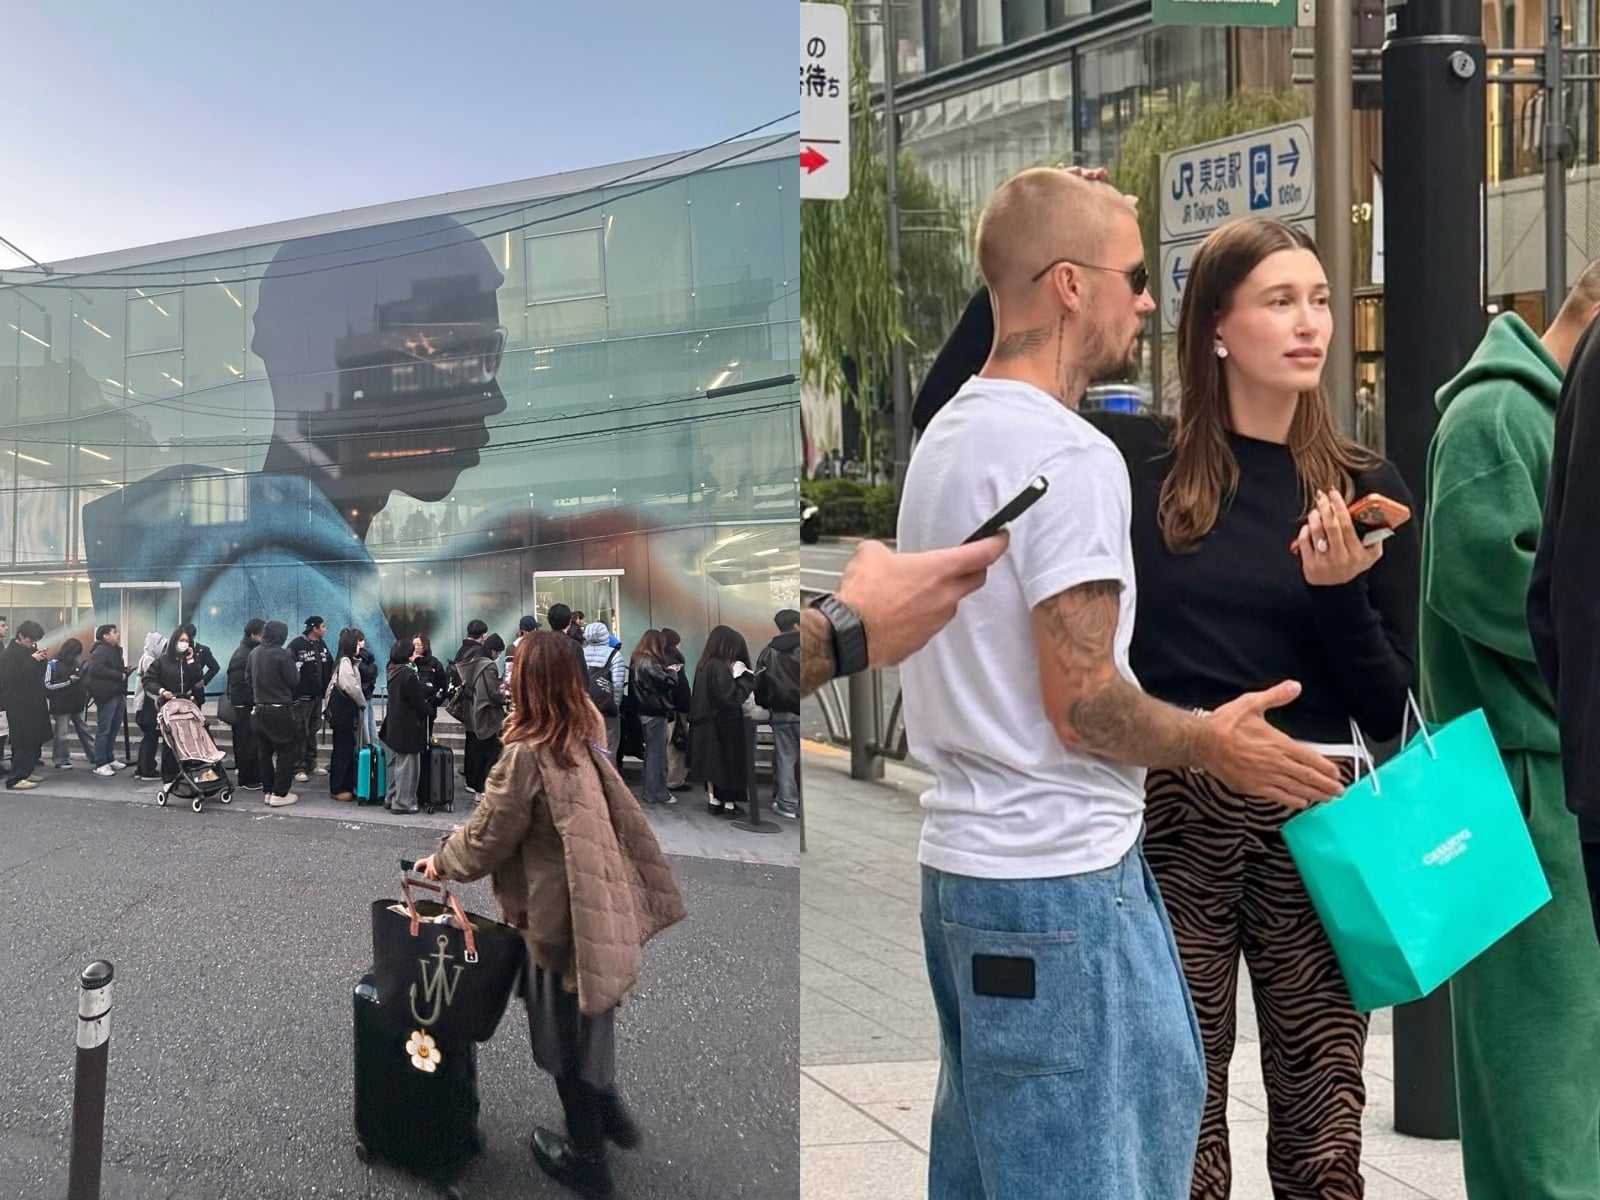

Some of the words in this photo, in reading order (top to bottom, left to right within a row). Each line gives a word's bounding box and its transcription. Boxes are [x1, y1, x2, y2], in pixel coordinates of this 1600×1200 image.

[807, 37, 826, 58] の
[800, 64, 840, 98] 待ち
[1172, 162, 1194, 200] JR
[1199, 152, 1242, 195] 東京駅
[1182, 204, 1192, 224] JR
[1193, 201, 1215, 223] Tokyo
